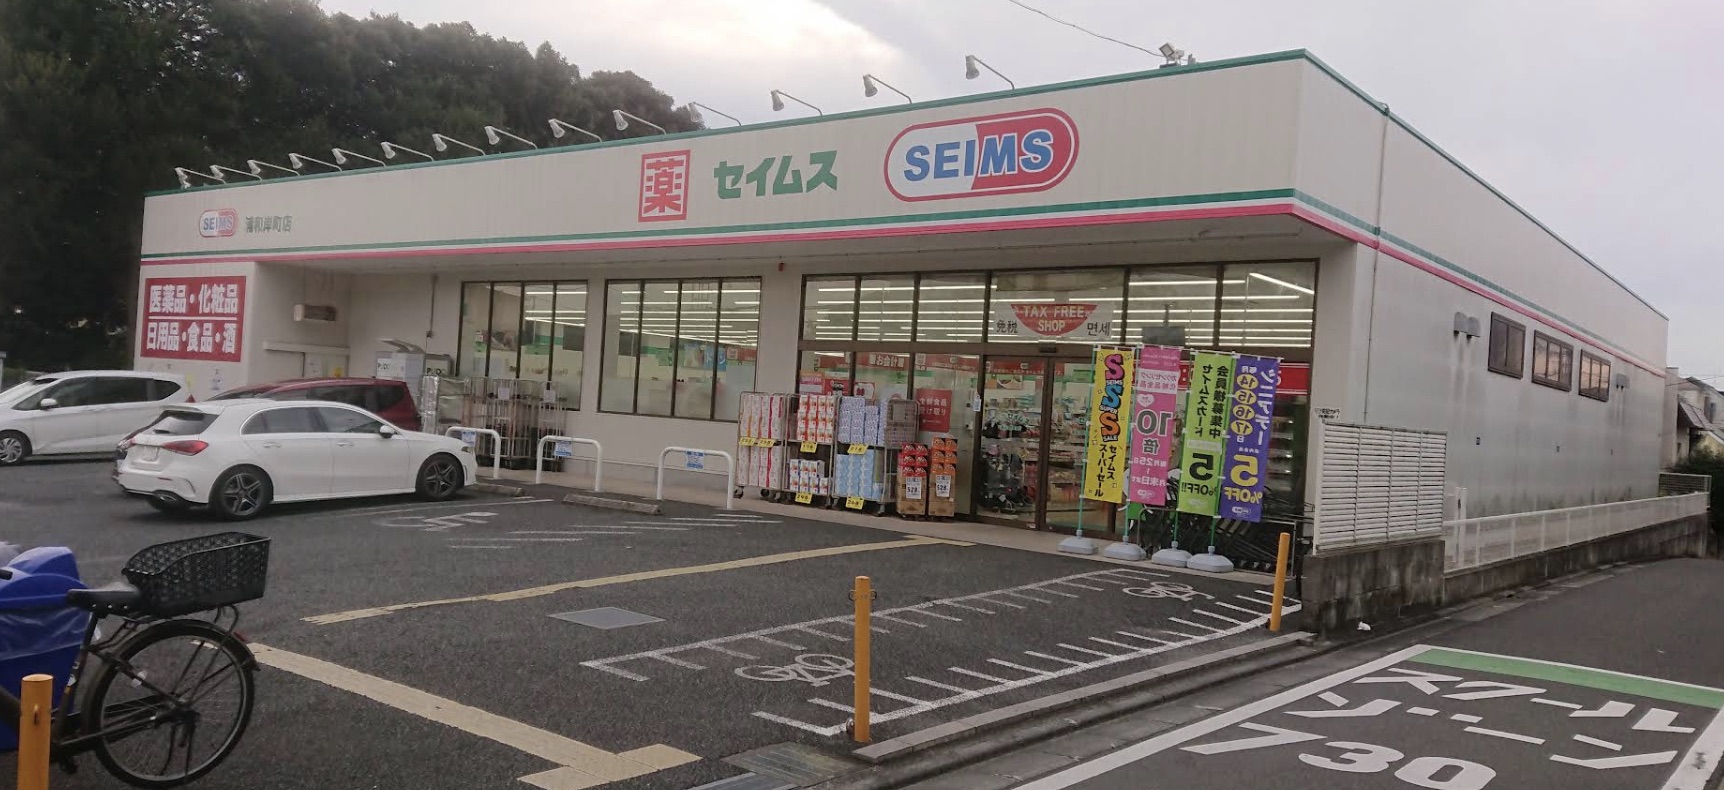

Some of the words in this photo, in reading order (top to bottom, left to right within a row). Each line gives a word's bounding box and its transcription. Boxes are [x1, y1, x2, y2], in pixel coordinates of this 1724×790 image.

[903, 127, 1056, 184] SEIMS
[643, 155, 686, 215] 薬
[713, 149, 838, 200] セイムス
[203, 215, 233, 232] SEIMS
[245, 215, 293, 234] 浦和岸町店
[148, 283, 239, 315] 医薬品・化粧品
[1023, 306, 1048, 318] TAX
[1053, 305, 1085, 318] FREE
[145, 321, 237, 355] 日用品・食品・酒
[996, 319, 1019, 334] 免税
[1037, 319, 1066, 332] SHOP
[1086, 321, 1111, 336] 면세
[1105, 353, 1125, 381] S
[1099, 405, 1118, 415] SUPER
[1101, 384, 1124, 410] S
[1099, 411, 1121, 437] S
[1102, 434, 1118, 442] SALE
[1094, 443, 1108, 497] スーパーセール
[1106, 445, 1118, 481] セイムス
[1354, 667, 1697, 734] スクール
[1284, 691, 1678, 770] ゾーン
